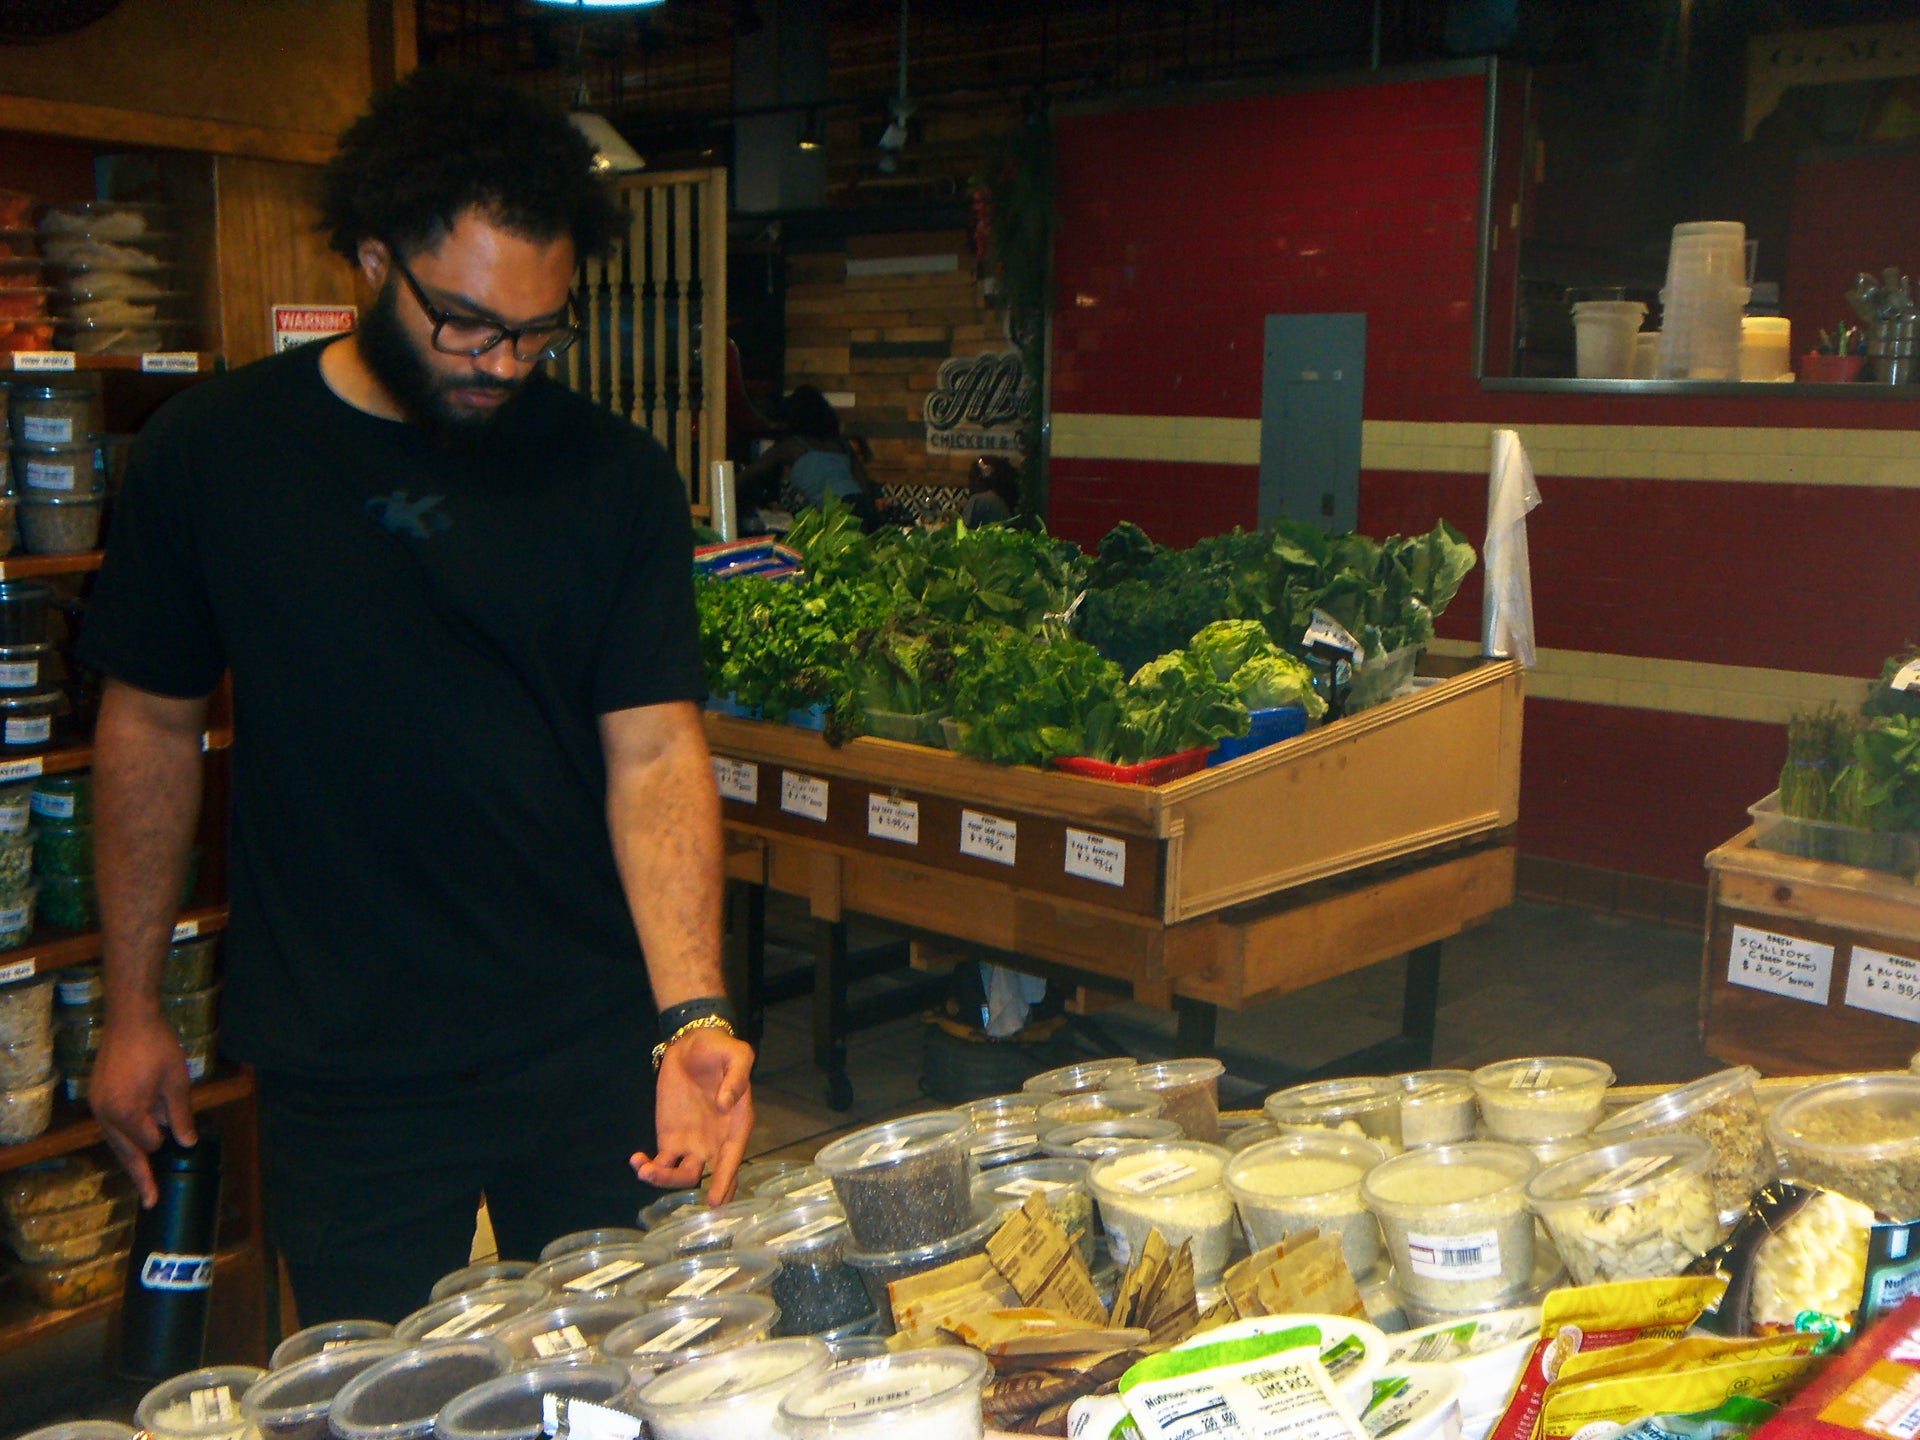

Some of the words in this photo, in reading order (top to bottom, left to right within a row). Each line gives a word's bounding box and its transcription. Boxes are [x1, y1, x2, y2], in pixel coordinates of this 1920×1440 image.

[278, 311, 353, 331] WARNING
[931, 433, 996, 450] CHICKEN
[1257, 1381, 1287, 1400] LIME
